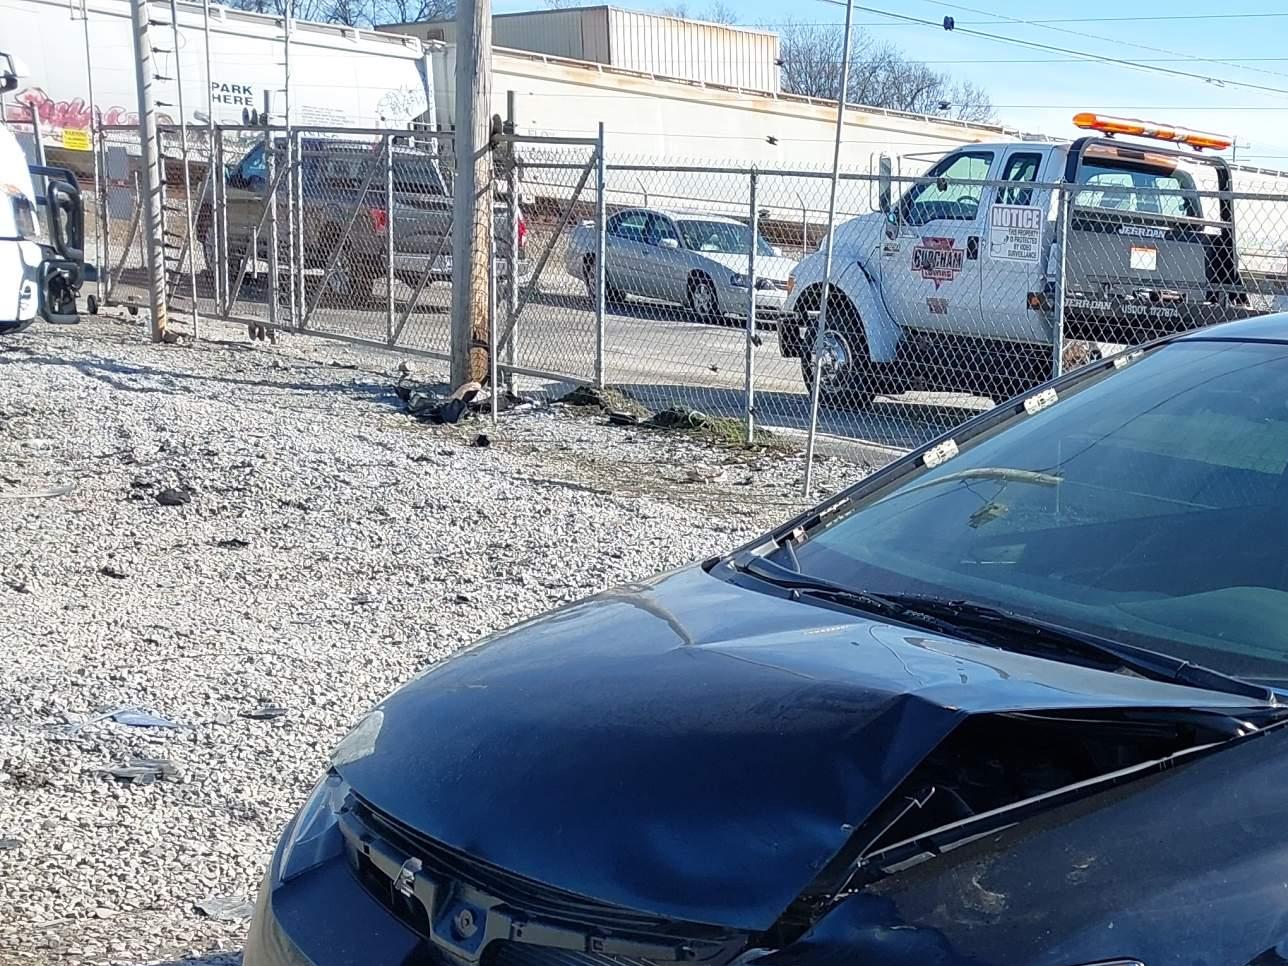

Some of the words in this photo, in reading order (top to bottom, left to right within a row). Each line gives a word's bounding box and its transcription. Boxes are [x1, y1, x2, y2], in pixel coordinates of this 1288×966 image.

[212, 82, 253, 95] PARK
[212, 93, 254, 106] HERE
[993, 208, 1040, 229] NOTICE
[1121, 304, 1147, 315] USDOT
